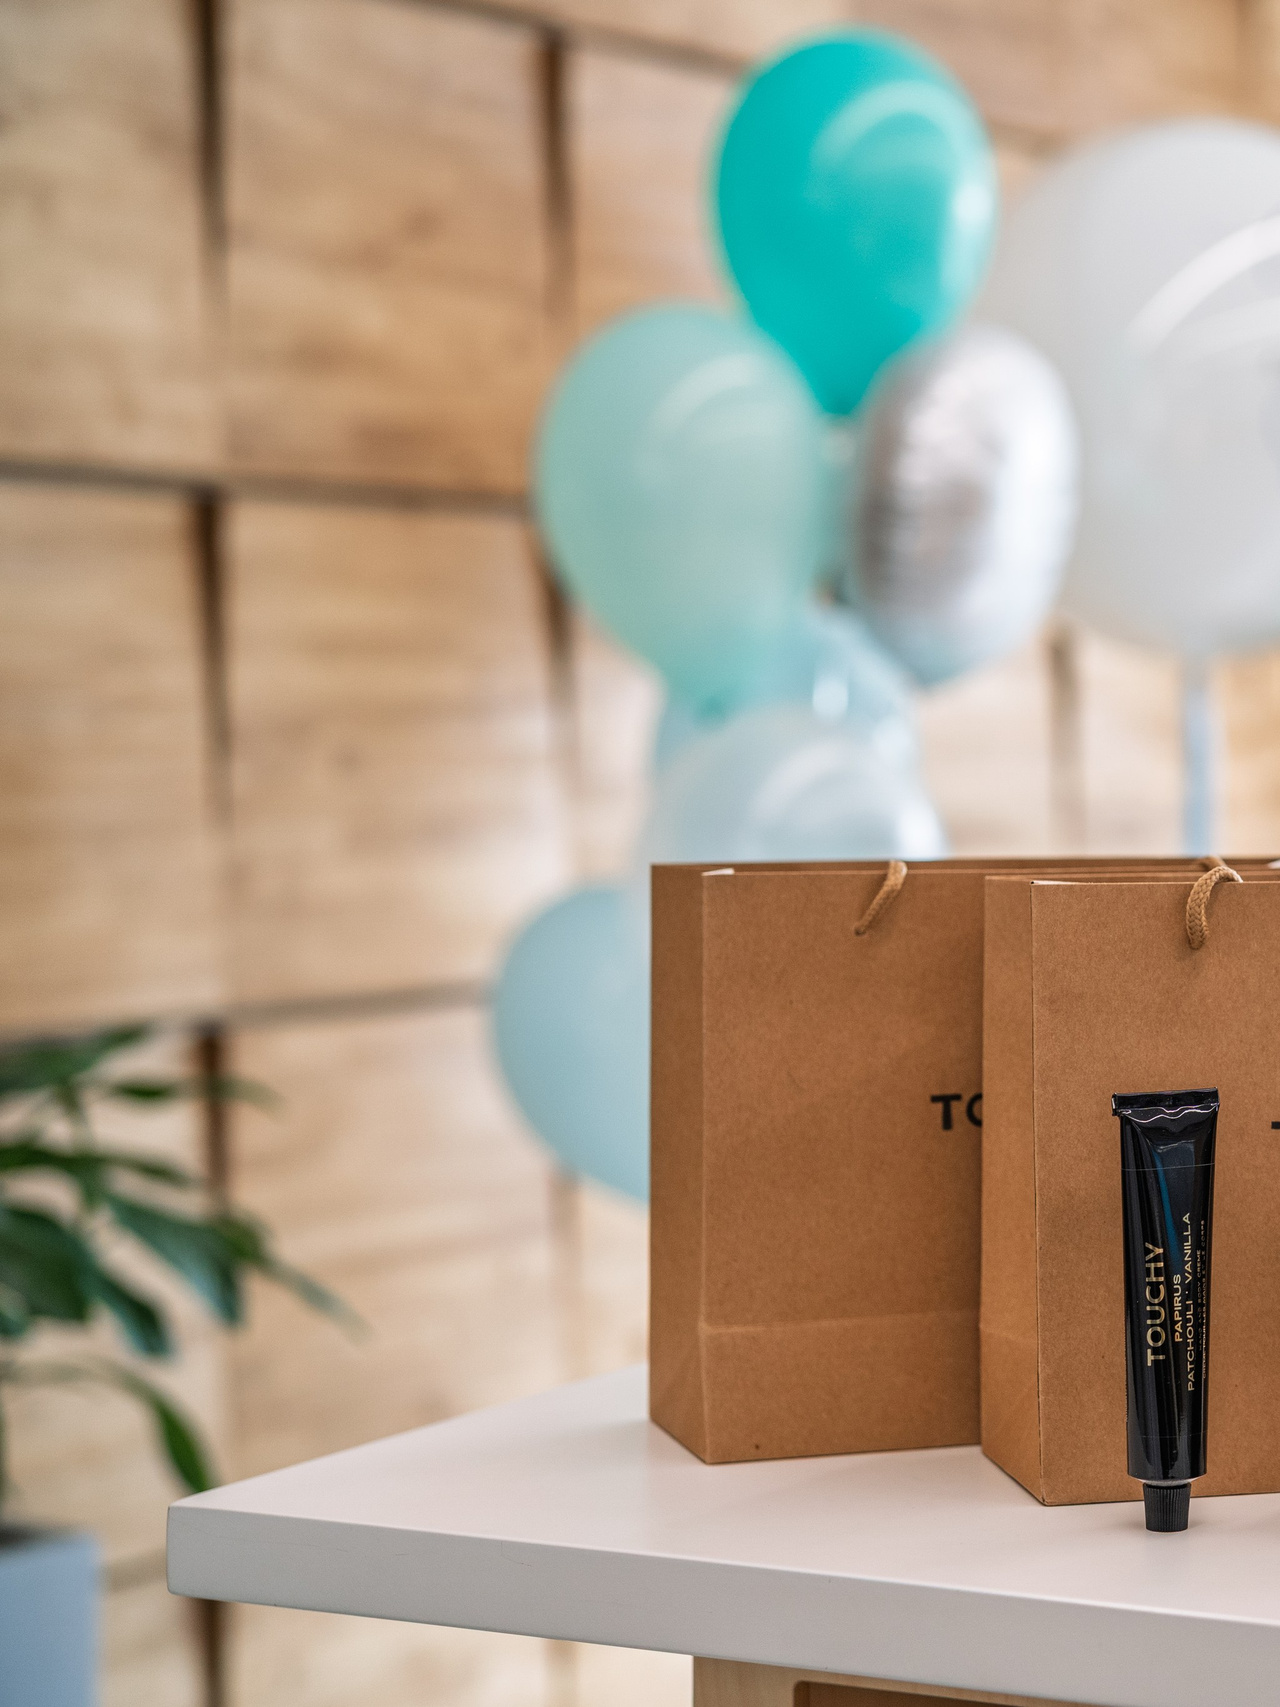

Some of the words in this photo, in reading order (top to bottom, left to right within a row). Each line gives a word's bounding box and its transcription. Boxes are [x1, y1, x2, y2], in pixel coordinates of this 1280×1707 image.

[1182, 1212, 1193, 1284] VANILLA
[1145, 1242, 1166, 1367] TOUCHY
[1173, 1274, 1183, 1343] PAPIRUS
[1185, 1300, 1195, 1391] PATCHOULI
